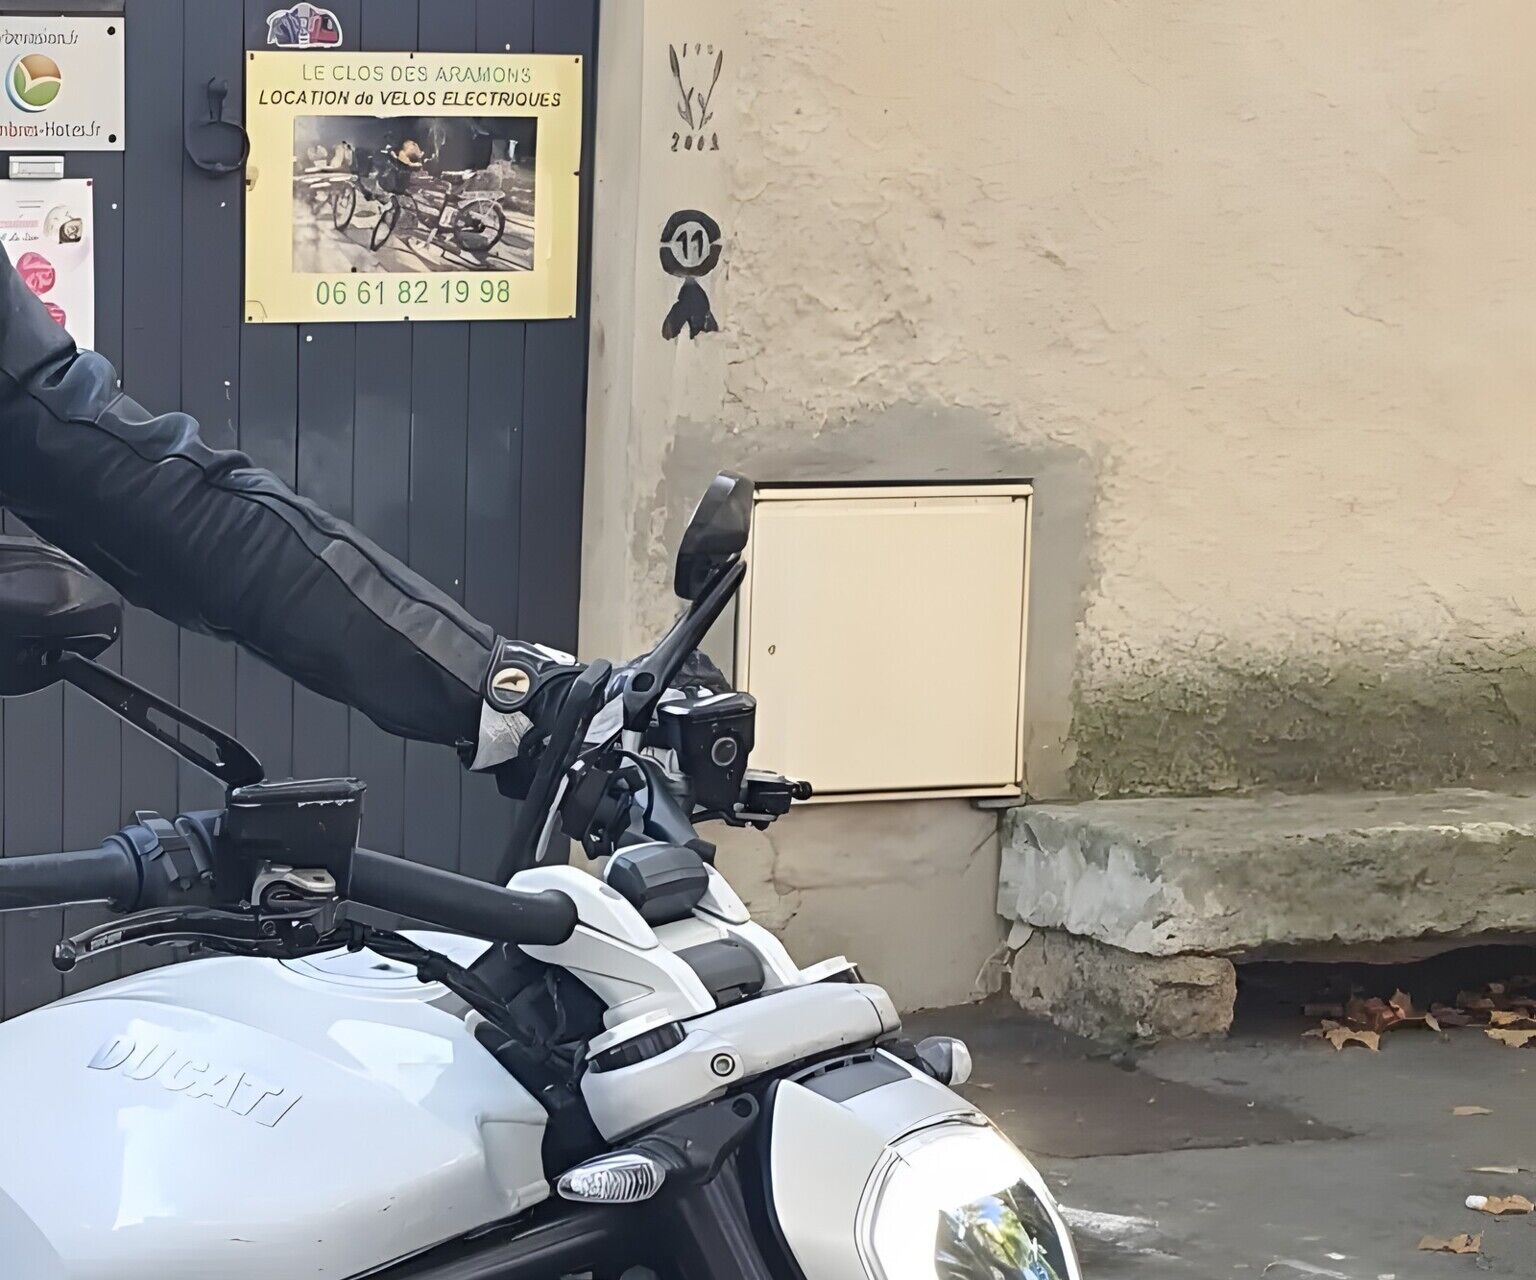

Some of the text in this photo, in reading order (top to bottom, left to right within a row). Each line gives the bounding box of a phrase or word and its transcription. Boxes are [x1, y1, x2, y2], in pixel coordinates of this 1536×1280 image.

[302, 63, 532, 84] LE CLOS DES ARAMONS
[258, 89, 350, 106] LOCATION
[380, 91, 437, 106] VELOS
[442, 91, 562, 108] ELECTRIQUES
[675, 230, 704, 261] 11
[316, 279, 511, 305] 06 61 82 19 98
[86, 1038, 303, 1128] DUCATI
